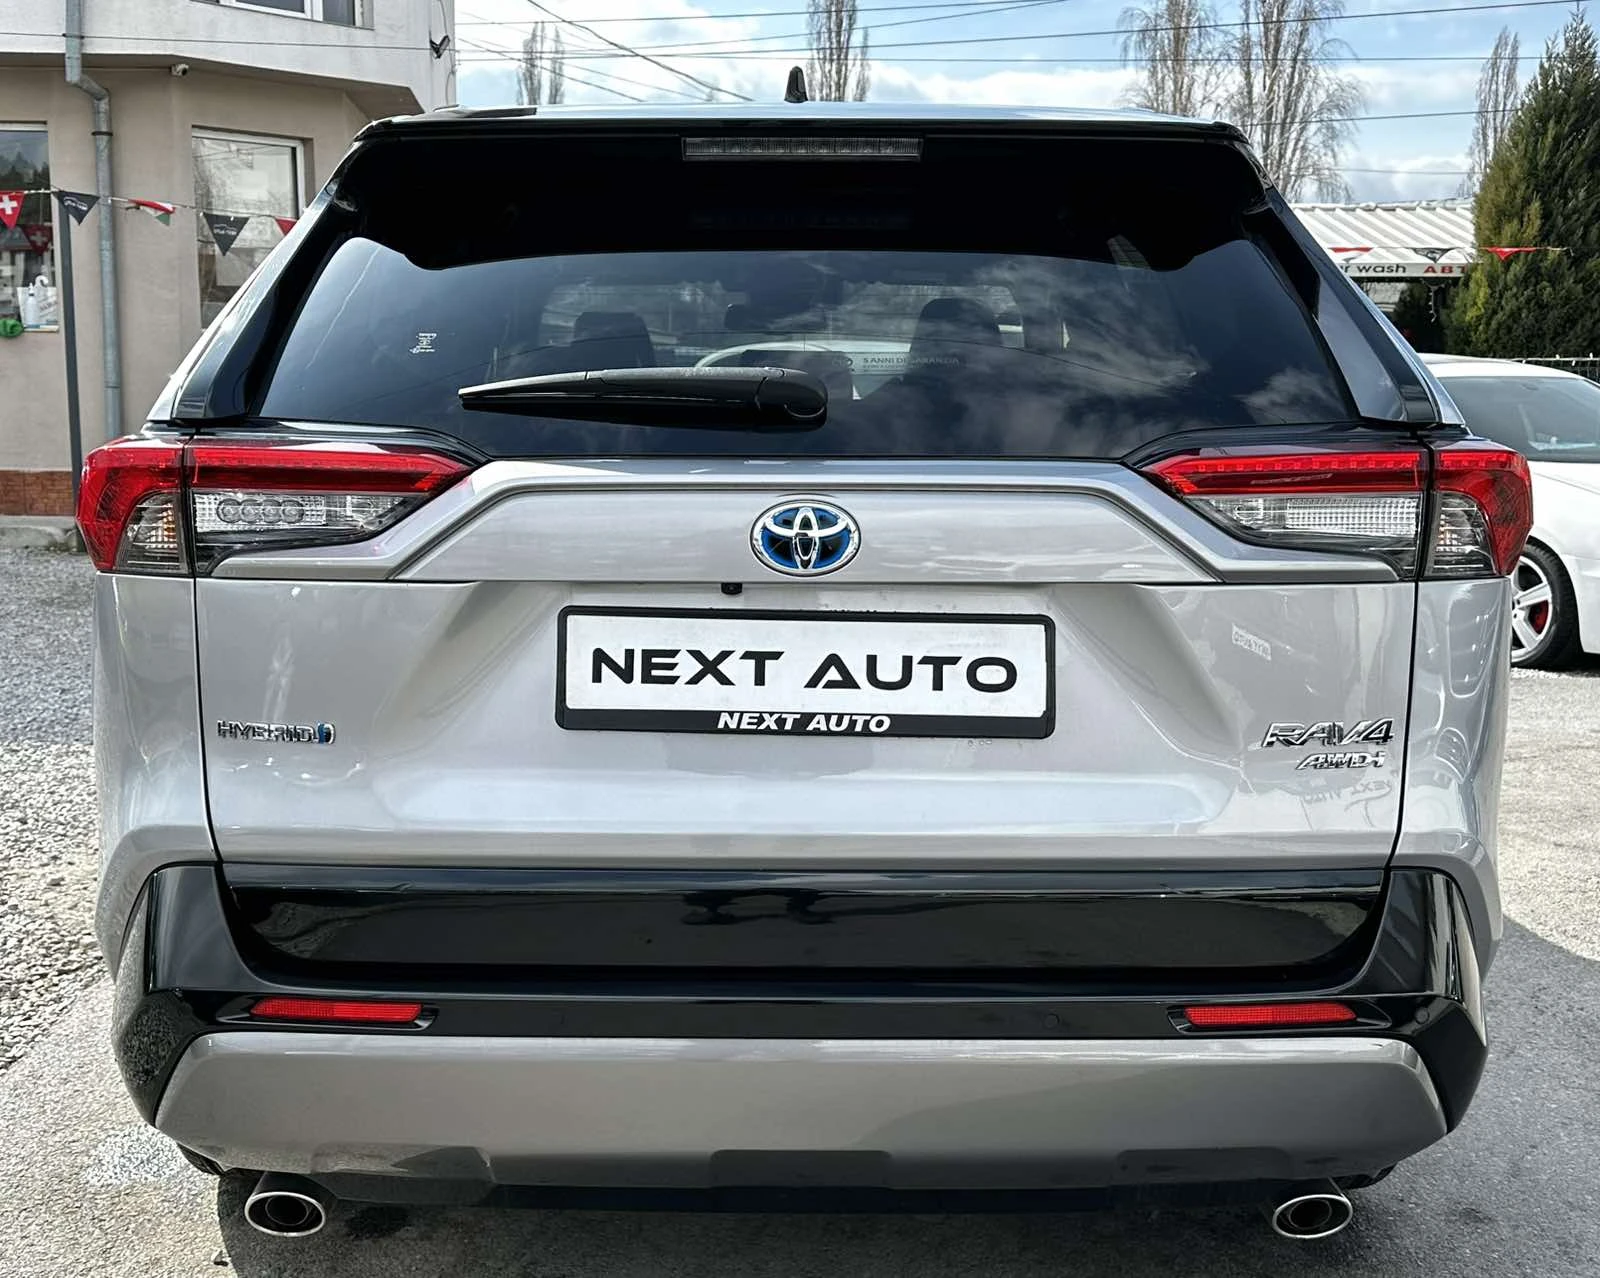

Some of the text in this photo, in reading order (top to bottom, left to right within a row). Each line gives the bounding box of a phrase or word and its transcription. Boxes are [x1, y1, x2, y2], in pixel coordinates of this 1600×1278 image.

[1357, 264, 1406, 273] wash
[591, 647, 1018, 692] NEXT AUTO
[217, 720, 315, 743] HYBRID
[717, 712, 891, 733] NEXT AUTO
[1261, 718, 1395, 746] RAV4
